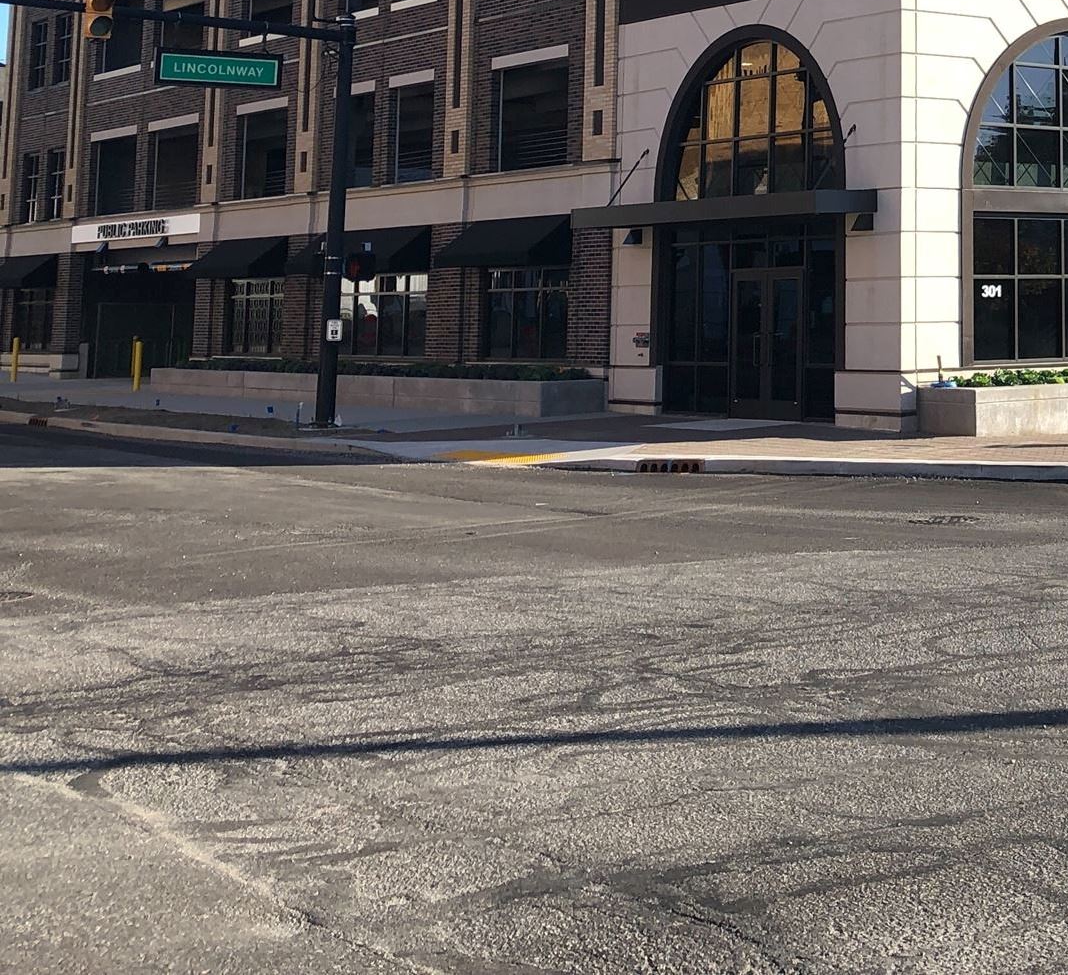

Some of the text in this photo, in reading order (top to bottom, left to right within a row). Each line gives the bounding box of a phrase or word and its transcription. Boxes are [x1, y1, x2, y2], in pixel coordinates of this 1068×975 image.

[173, 62, 263, 77] LINCOLNWAY
[97, 219, 168, 239] PUBLIC PARKING
[981, 284, 1002, 298] 301
